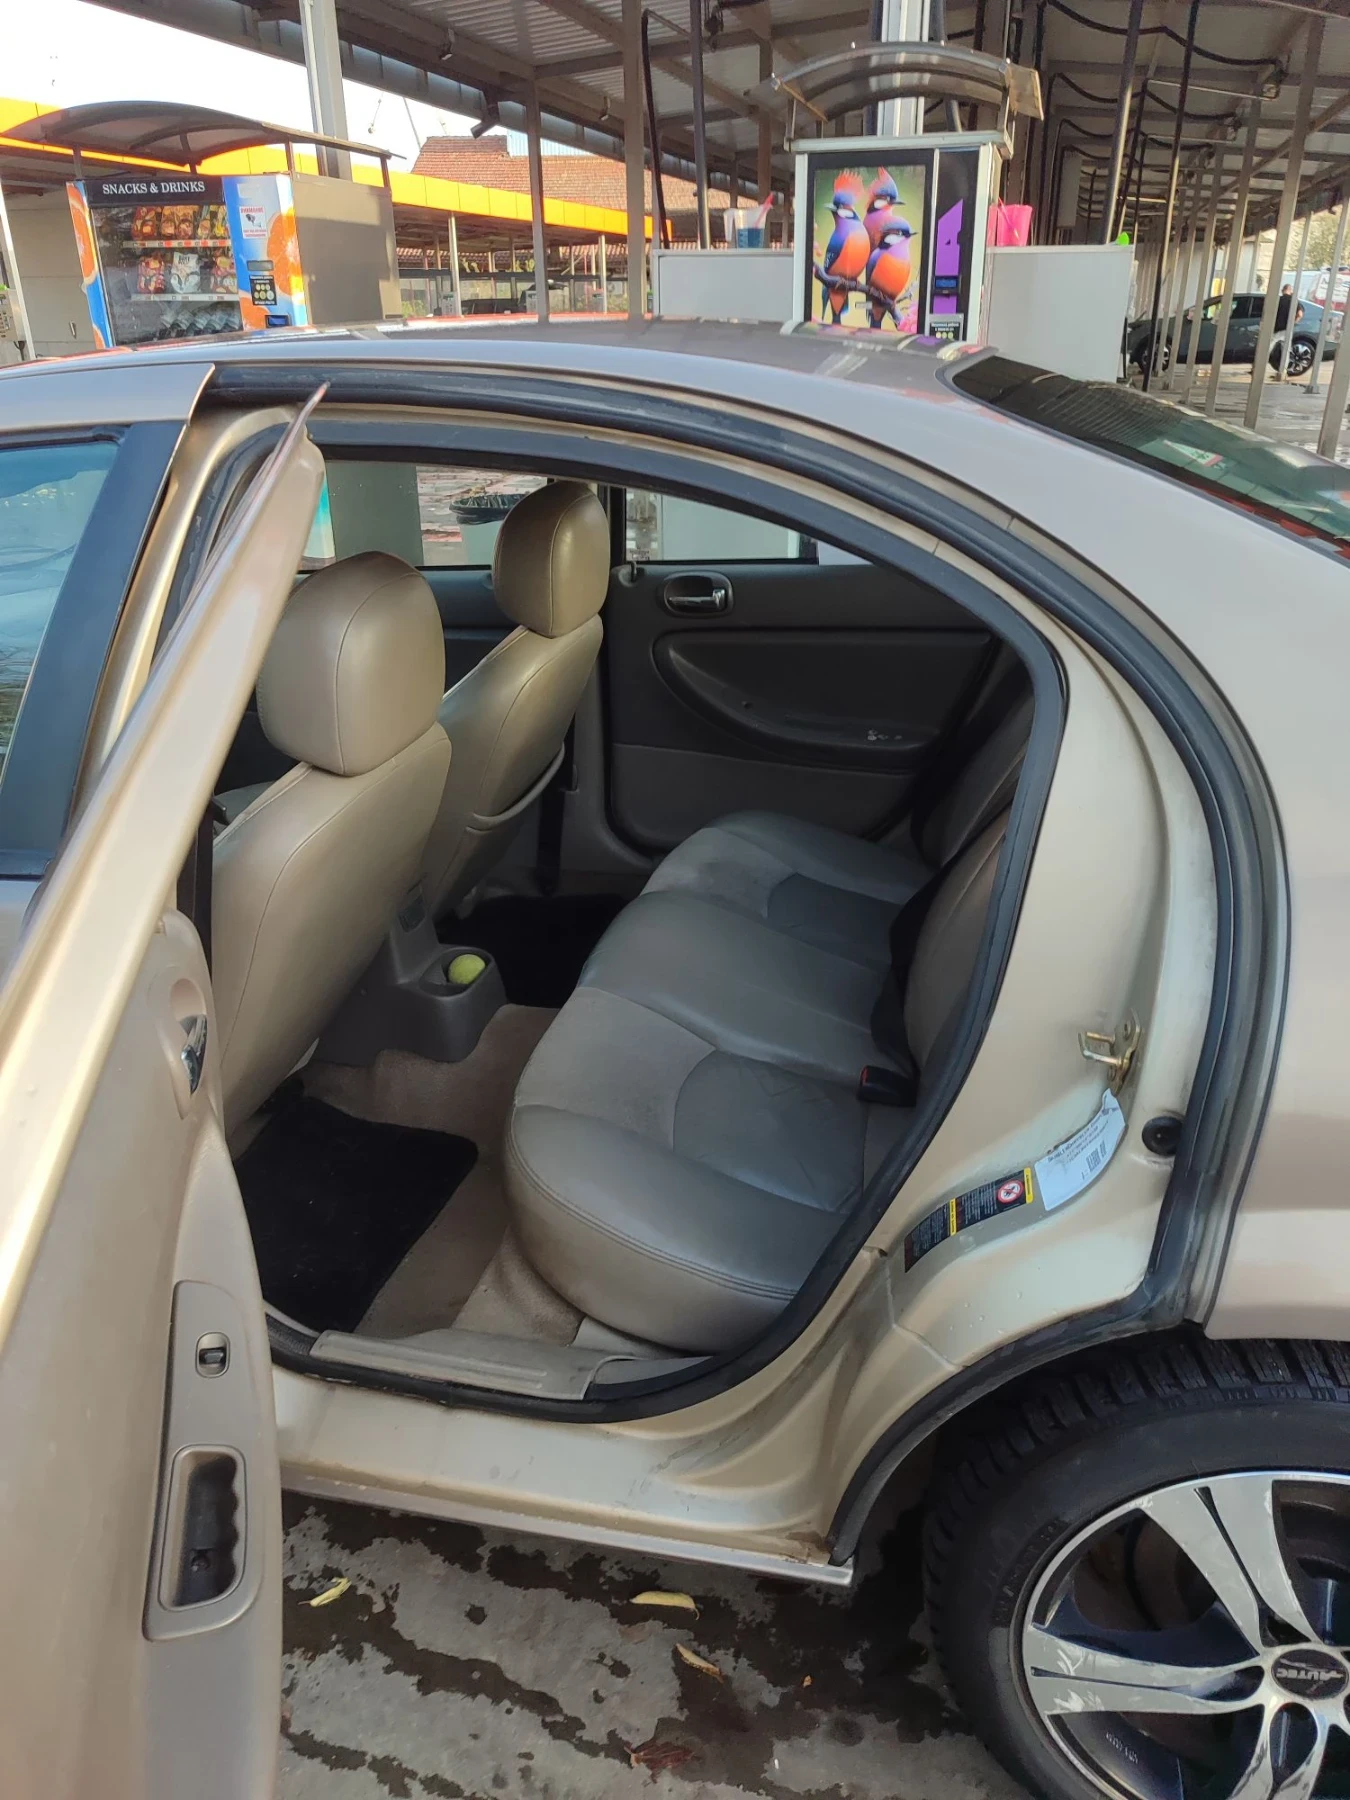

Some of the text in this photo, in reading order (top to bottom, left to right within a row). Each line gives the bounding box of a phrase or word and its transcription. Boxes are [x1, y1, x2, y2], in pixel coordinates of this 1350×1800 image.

[102, 180, 206, 195] SNACKS & DRINKS
